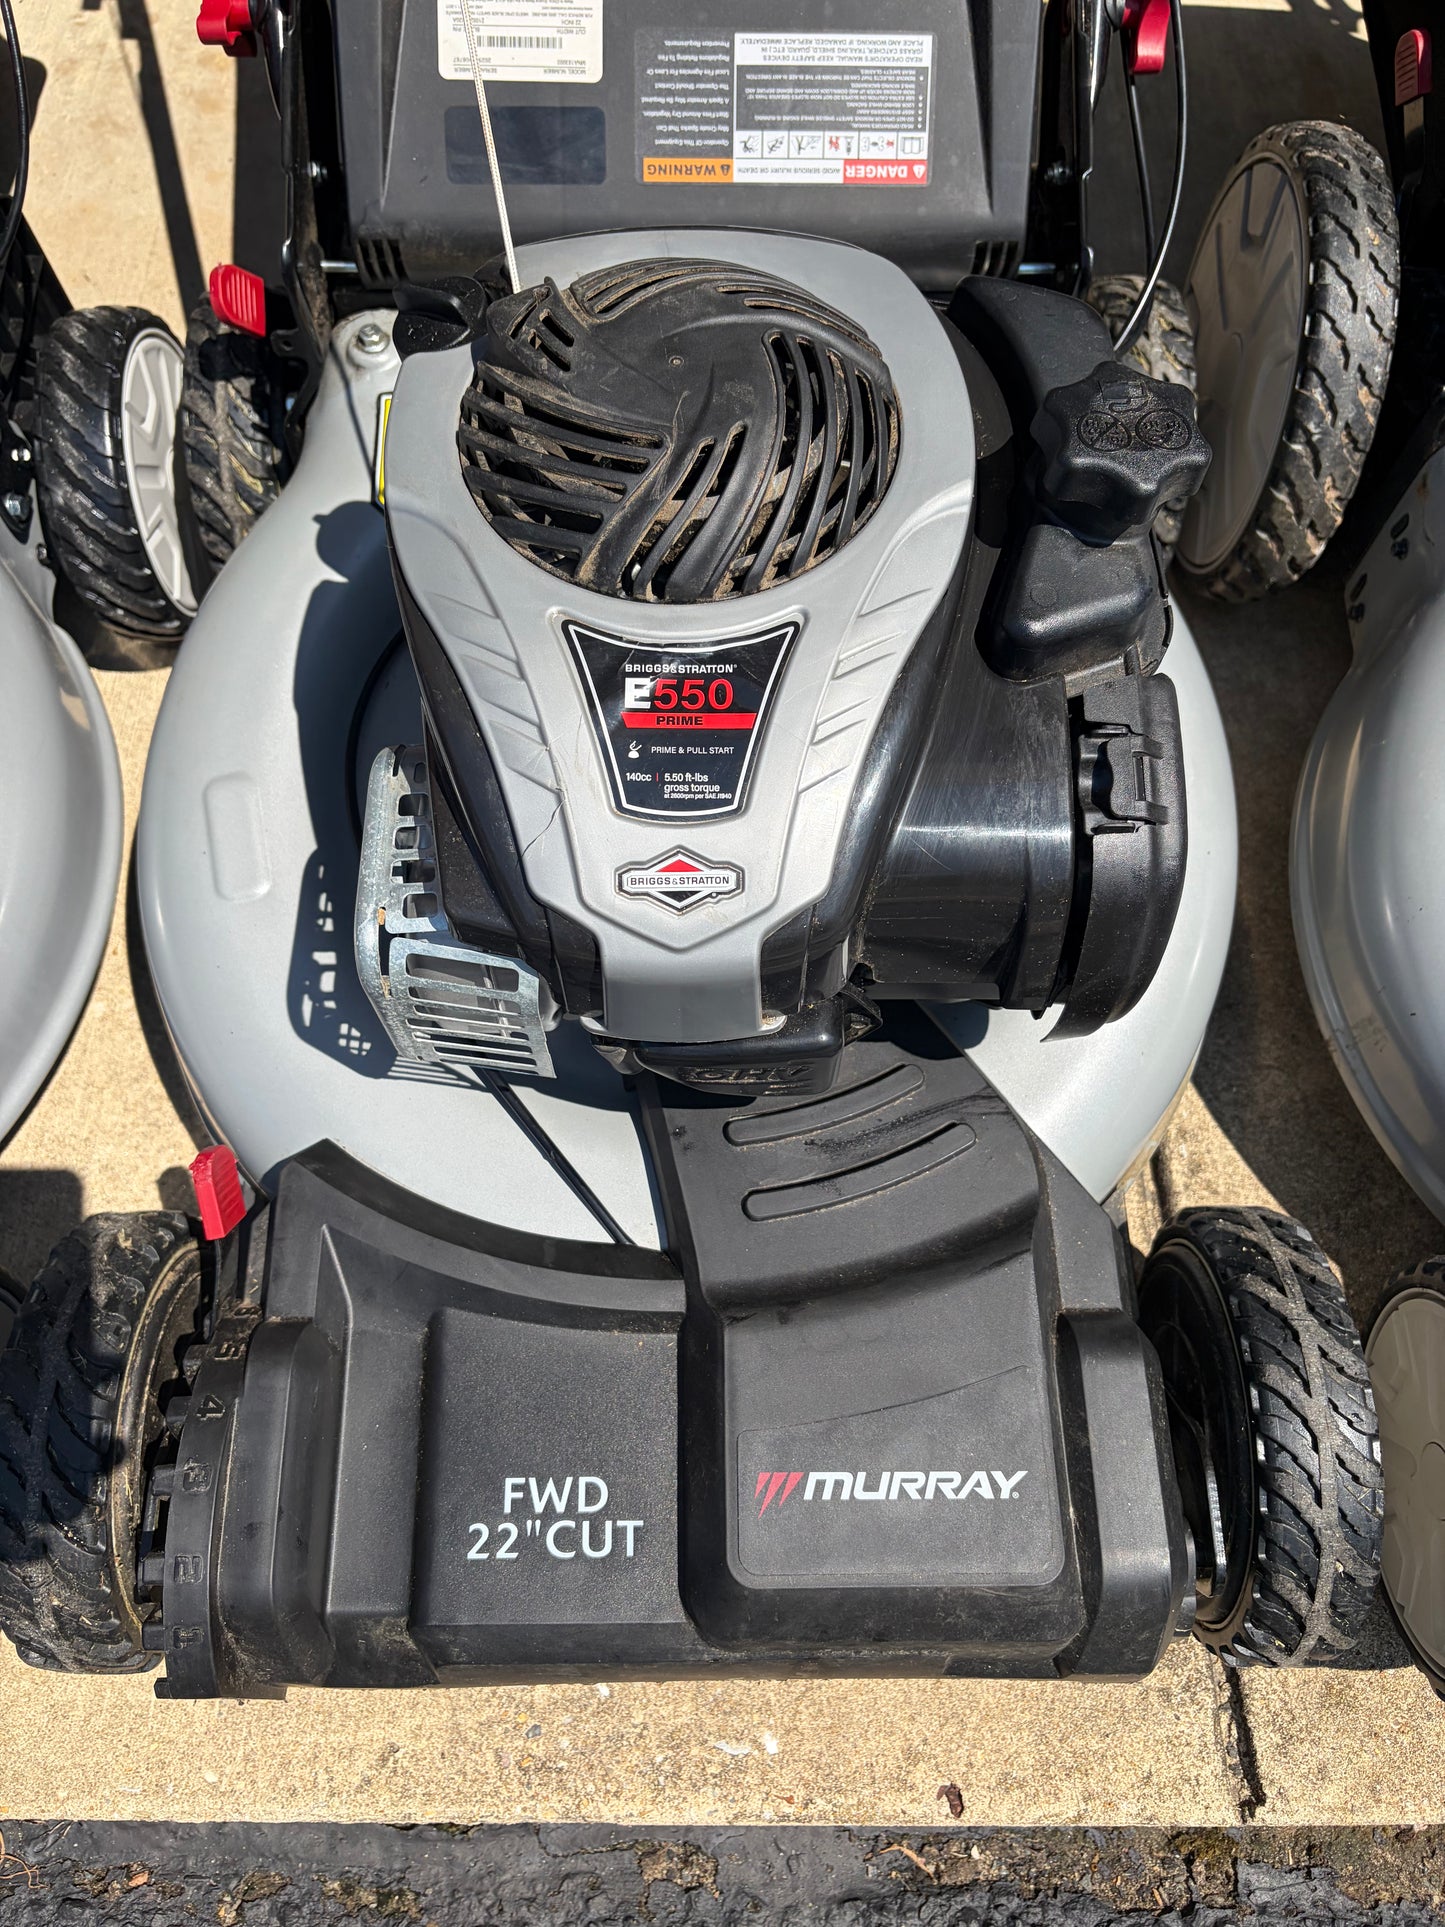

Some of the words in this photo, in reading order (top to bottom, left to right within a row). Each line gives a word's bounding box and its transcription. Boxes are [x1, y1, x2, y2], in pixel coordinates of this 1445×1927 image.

[761, 46, 767, 54] IN
[899, 47, 923, 55] (GRASS
[657, 54, 669, 62] Fire
[669, 54, 676, 62] To
[676, 54, 699, 62] Relating
[699, 54, 730, 62] Regulations
[646, 68, 654, 76] Or
[654, 68, 669, 76] Laws
[669, 68, 679, 76] For
[679, 68, 703, 76] Agencies
[704, 68, 714, 76] Fire
[715, 68, 730, 76] Local
[671, 110, 682, 118] Dry
[682, 110, 702, 118] Around
[702, 110, 715, 118] Fires
[716, 110, 729, 118] Start
[656, 124, 667, 132] Can
[668, 124, 679, 132] That
[680, 124, 699, 132] Sparks
[700, 124, 717, 132] Create
[717, 124, 729, 132] May
[654, 138, 683, 147] Equipment
[683, 138, 695, 147] This
[695, 138, 703, 147] Of
[704, 138, 729, 147] Operation
[647, 164, 716, 176] WARNING
[845, 165, 908, 178] DANGER
[625, 677, 734, 710] E550
[656, 716, 703, 726] PRIME
[626, 772, 652, 781] 140cc
[664, 773, 684, 782] 5.50
[685, 773, 709, 782] ft-lbs
[664, 785, 689, 793] gross
[691, 784, 720, 794] torque
[630, 876, 730, 886] BRIGGS&STRATTON
[197, 1394, 226, 1420] 4
[803, 1471, 1028, 1500] MURRAY
[503, 1476, 609, 1514] FWD
[467, 1519, 644, 1560] 22"CUT
[173, 1554, 203, 1584] 2
